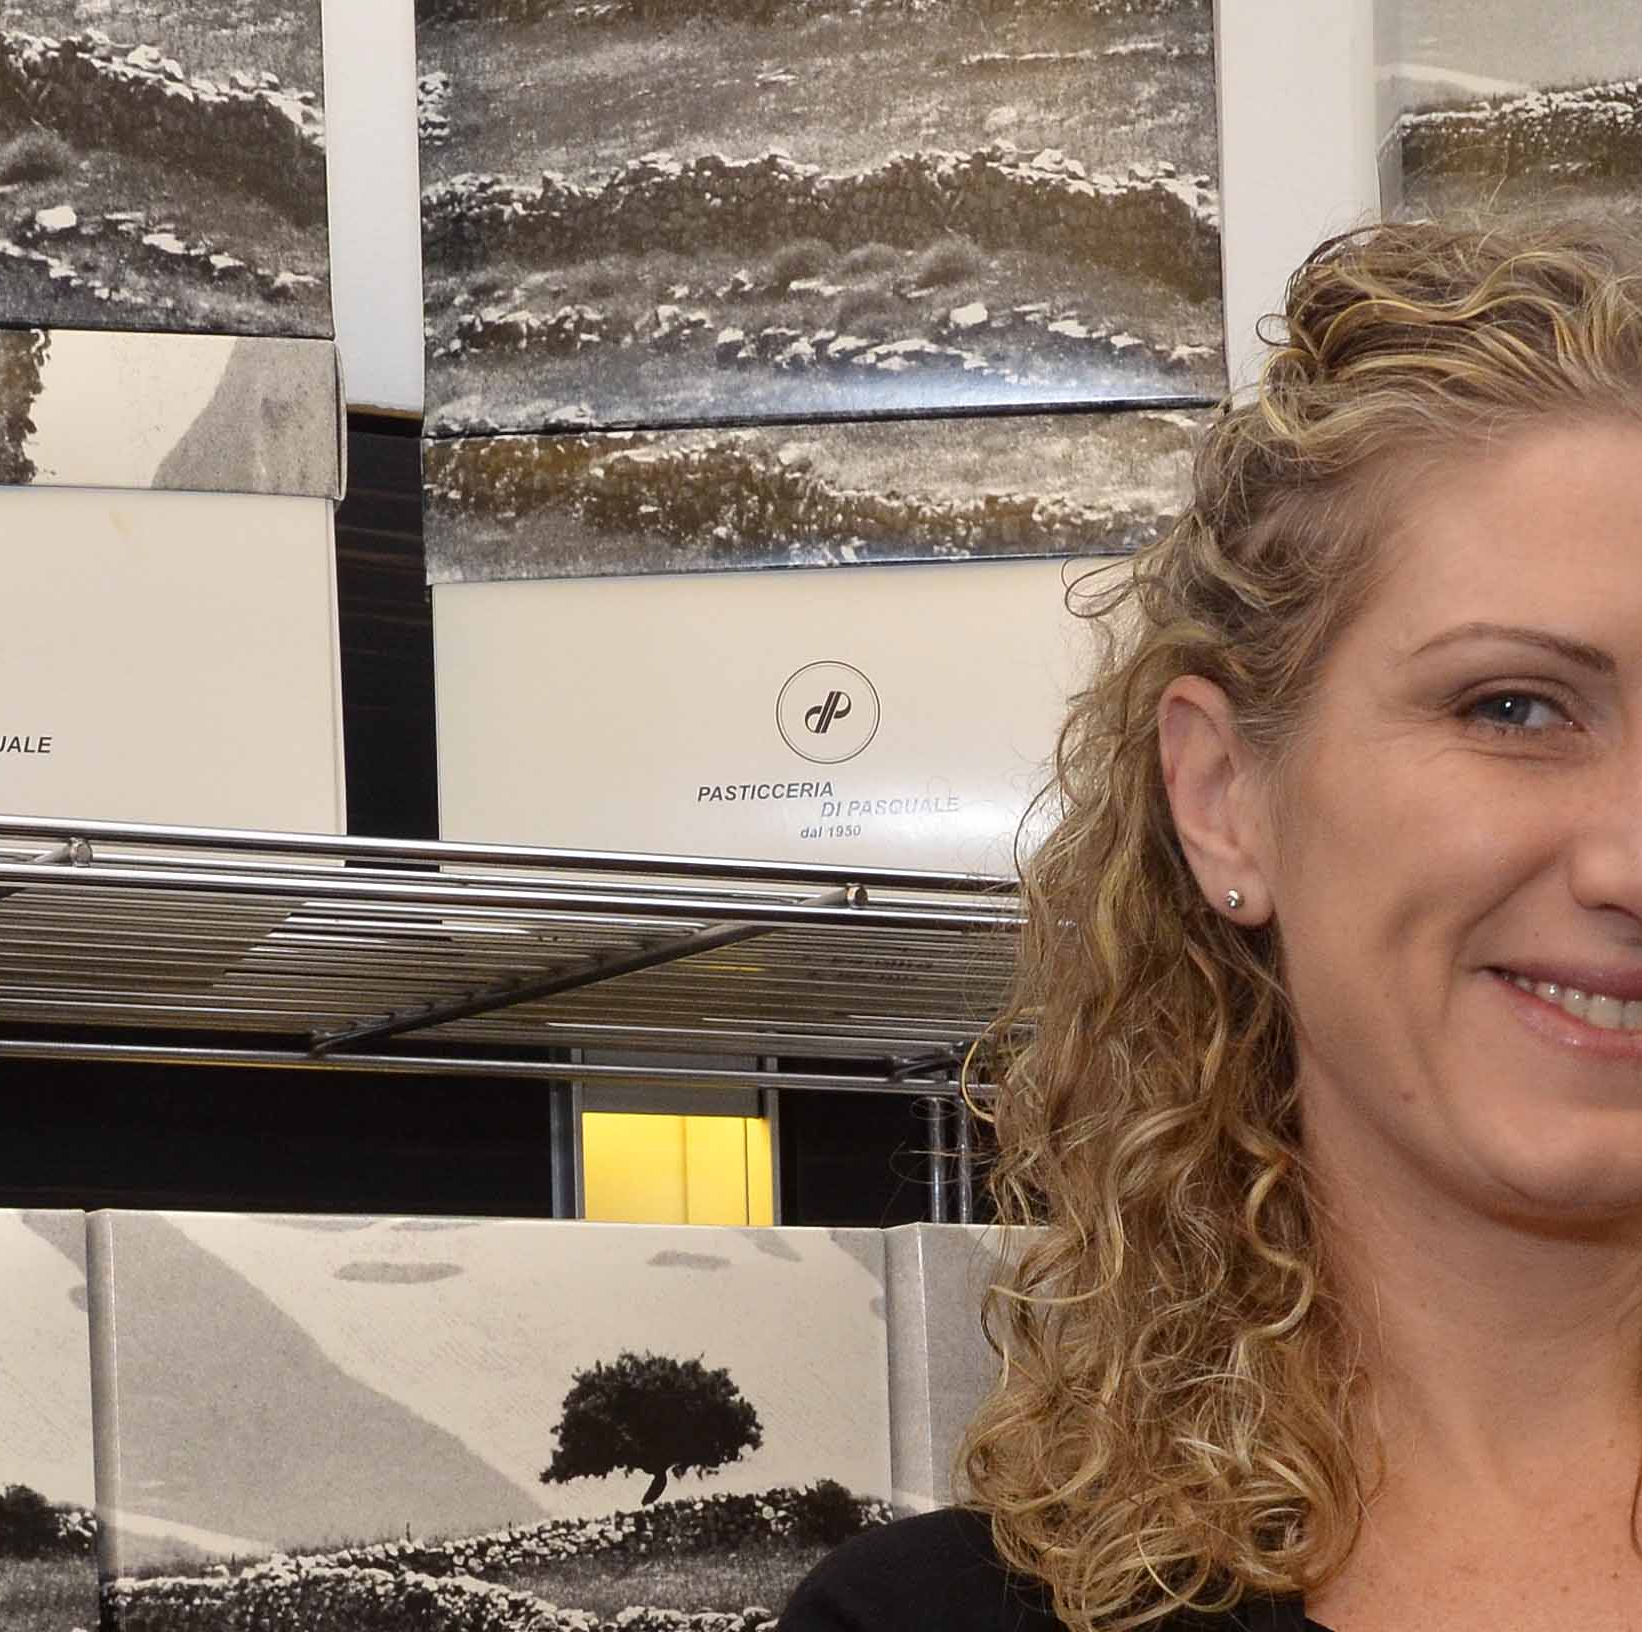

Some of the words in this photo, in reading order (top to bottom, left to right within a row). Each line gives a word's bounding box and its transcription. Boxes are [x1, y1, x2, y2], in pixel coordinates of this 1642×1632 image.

[697, 781, 834, 802] PASTICCERIA
[820, 802, 841, 819] DI
[847, 797, 960, 817] PASQUALE
[800, 826, 823, 839] dal
[828, 825, 862, 838] 1950
